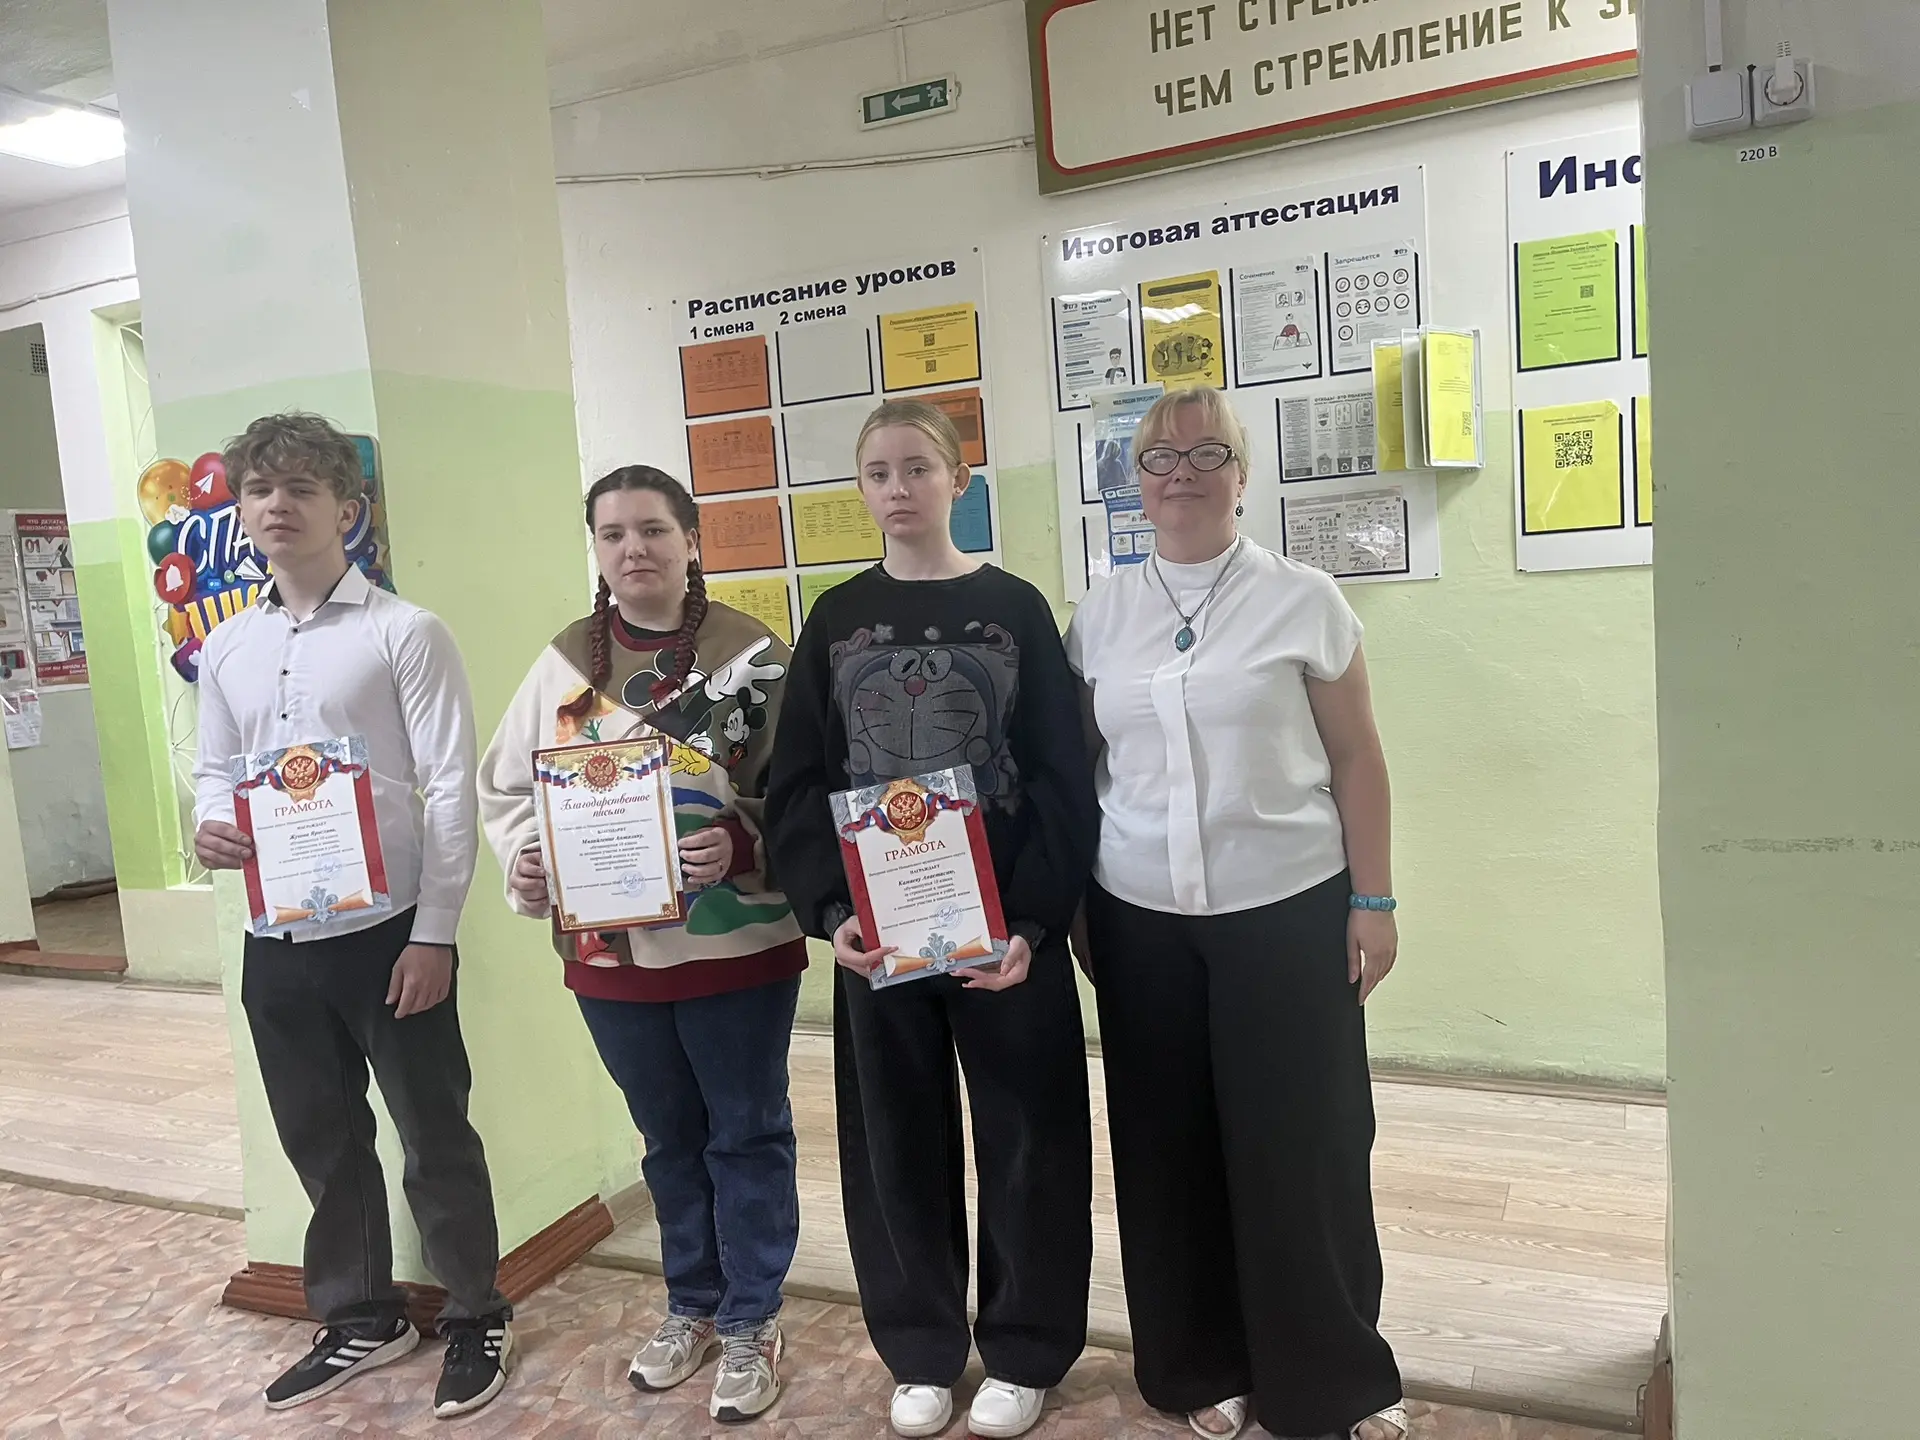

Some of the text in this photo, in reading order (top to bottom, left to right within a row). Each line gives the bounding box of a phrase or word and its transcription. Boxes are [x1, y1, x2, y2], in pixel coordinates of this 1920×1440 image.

[1150, 4, 1216, 54] НЕТ
[1154, 69, 1232, 116] ЧЕМ
[1254, 2, 1522, 97] СТРЕМЛЕНИЕ
[1549, 0, 1571, 31] К
[1740, 145, 1778, 163] 220 В
[1061, 184, 1400, 262] Итоговая аттестация
[1334, 252, 1381, 266] Запрещается
[1239, 269, 1276, 281] Сочинение
[688, 277, 848, 319] Расписание
[856, 259, 956, 296] уроков
[779, 302, 847, 326] 2 смена
[689, 319, 755, 340] 1 смена
[25, 538, 41, 554] 01
[274, 799, 334, 817] ГРАМОТА
[560, 793, 651, 811] Благодарственное
[592, 807, 626, 818] письмо
[884, 839, 946, 862] ГРАМОТА
